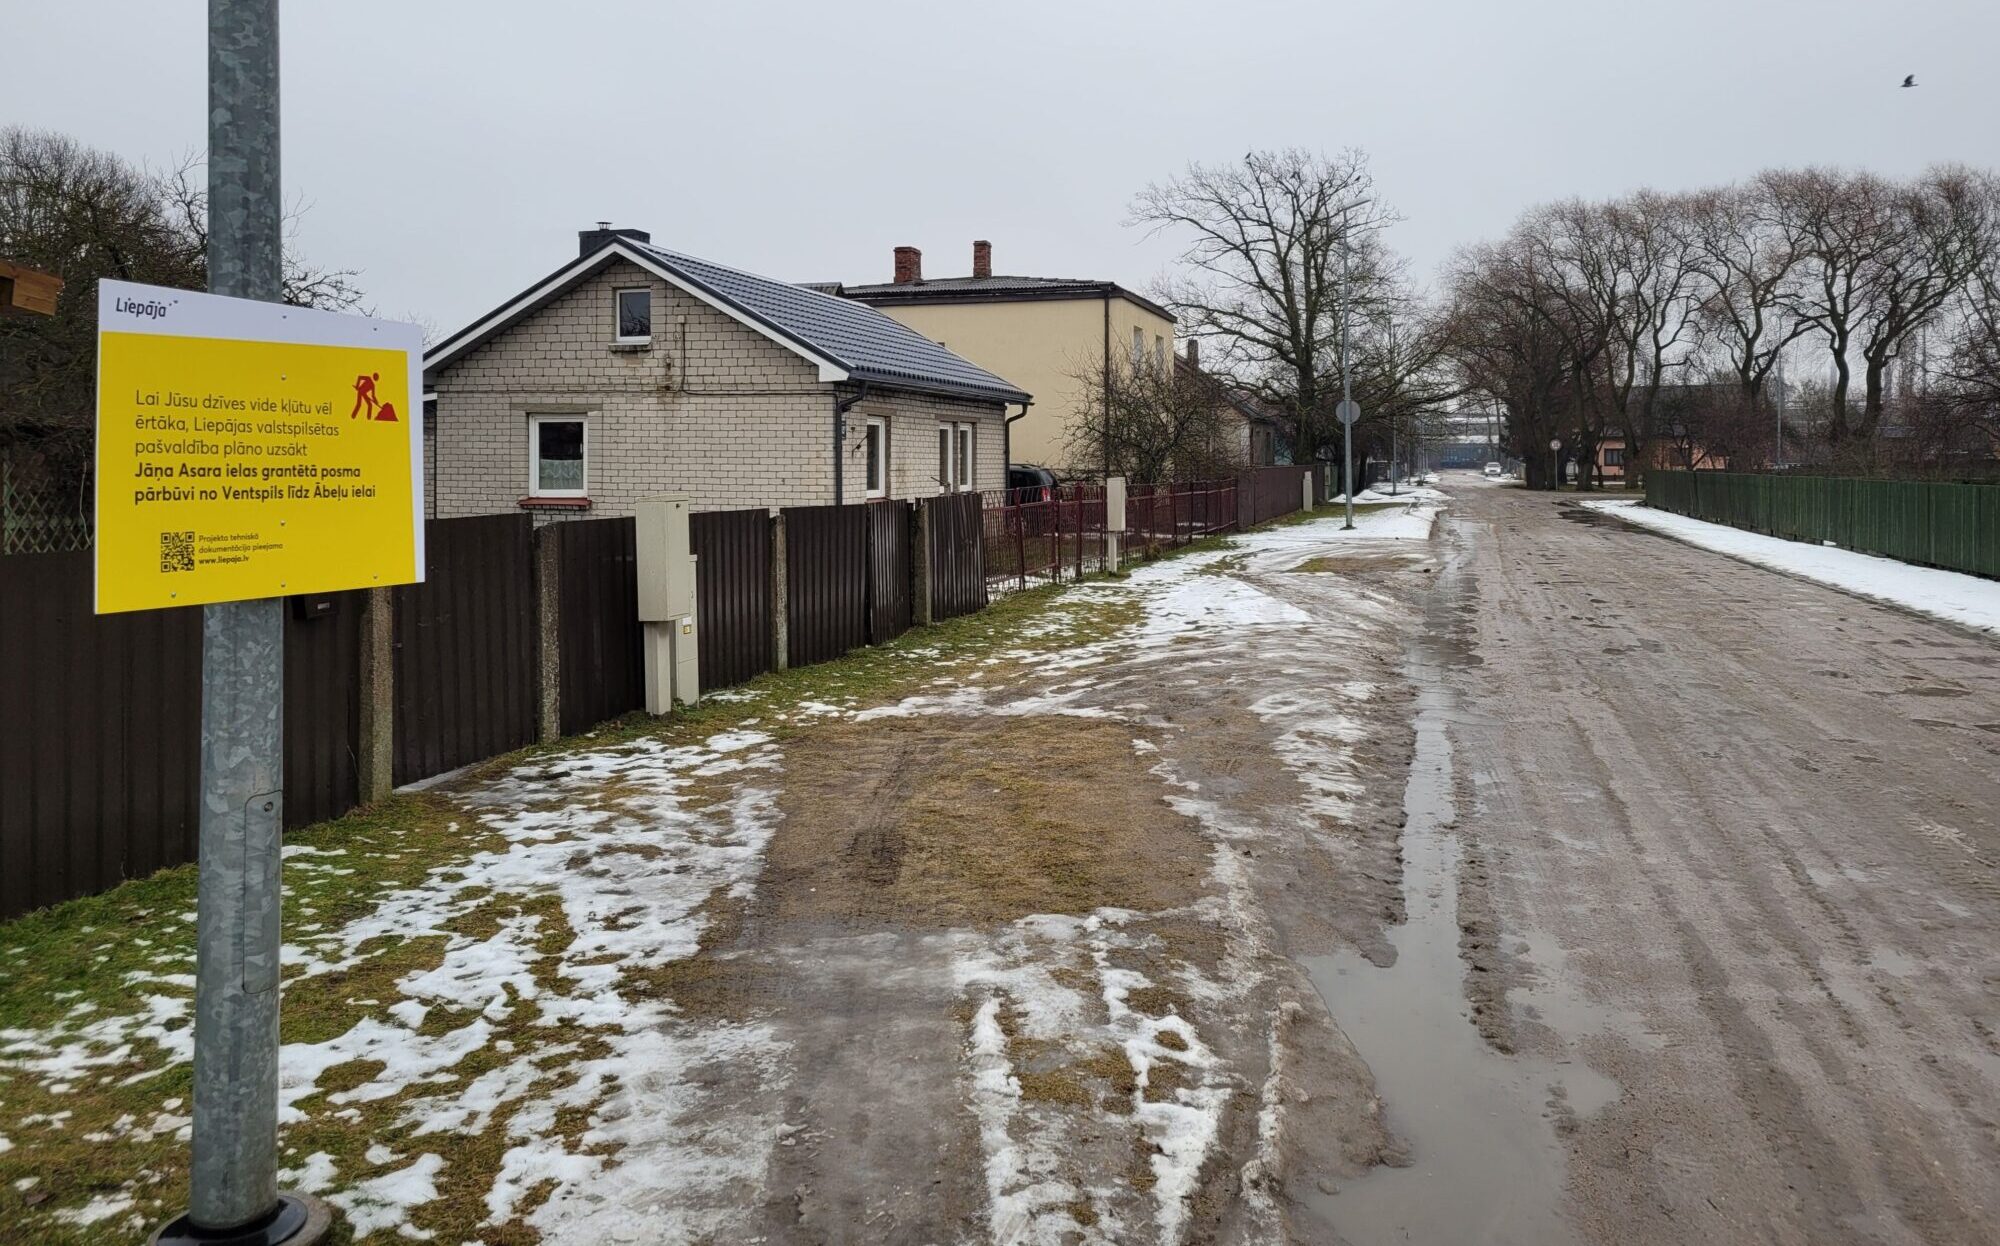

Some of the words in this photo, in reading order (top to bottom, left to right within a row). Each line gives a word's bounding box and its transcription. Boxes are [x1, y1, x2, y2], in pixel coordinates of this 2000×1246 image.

[135, 390, 160, 406] Lai
[165, 391, 198, 409] Jūsu
[202, 394, 246, 411] dzīves
[250, 398, 278, 412] vide
[281, 399, 312, 417] kļūtu
[315, 402, 333, 415] vēl
[135, 415, 189, 434] ērtāka,
[195, 417, 253, 437] Liepājas
[257, 419, 340, 439] valstspilsētas
[135, 439, 220, 458] pašvaldība
[224, 440, 263, 459] plāno
[267, 443, 308, 457] uzsākt
[135, 462, 174, 482] Jāņa
[178, 462, 222, 478] Asara
[226, 463, 258, 478] ielas
[262, 464, 318, 482] grantētā
[321, 467, 361, 482] posma
[135, 486, 195, 506] pārbūvi
[200, 490, 218, 501] no
[222, 485, 284, 503] Ventspils
[288, 484, 310, 500] līdz
[313, 481, 349, 503] Ābeļu
[352, 484, 376, 499] ielai
[198, 534, 229, 544] Projekta
[252, 542, 284, 552] pieejama
[198, 555, 250, 565] www.liepaja.lv
